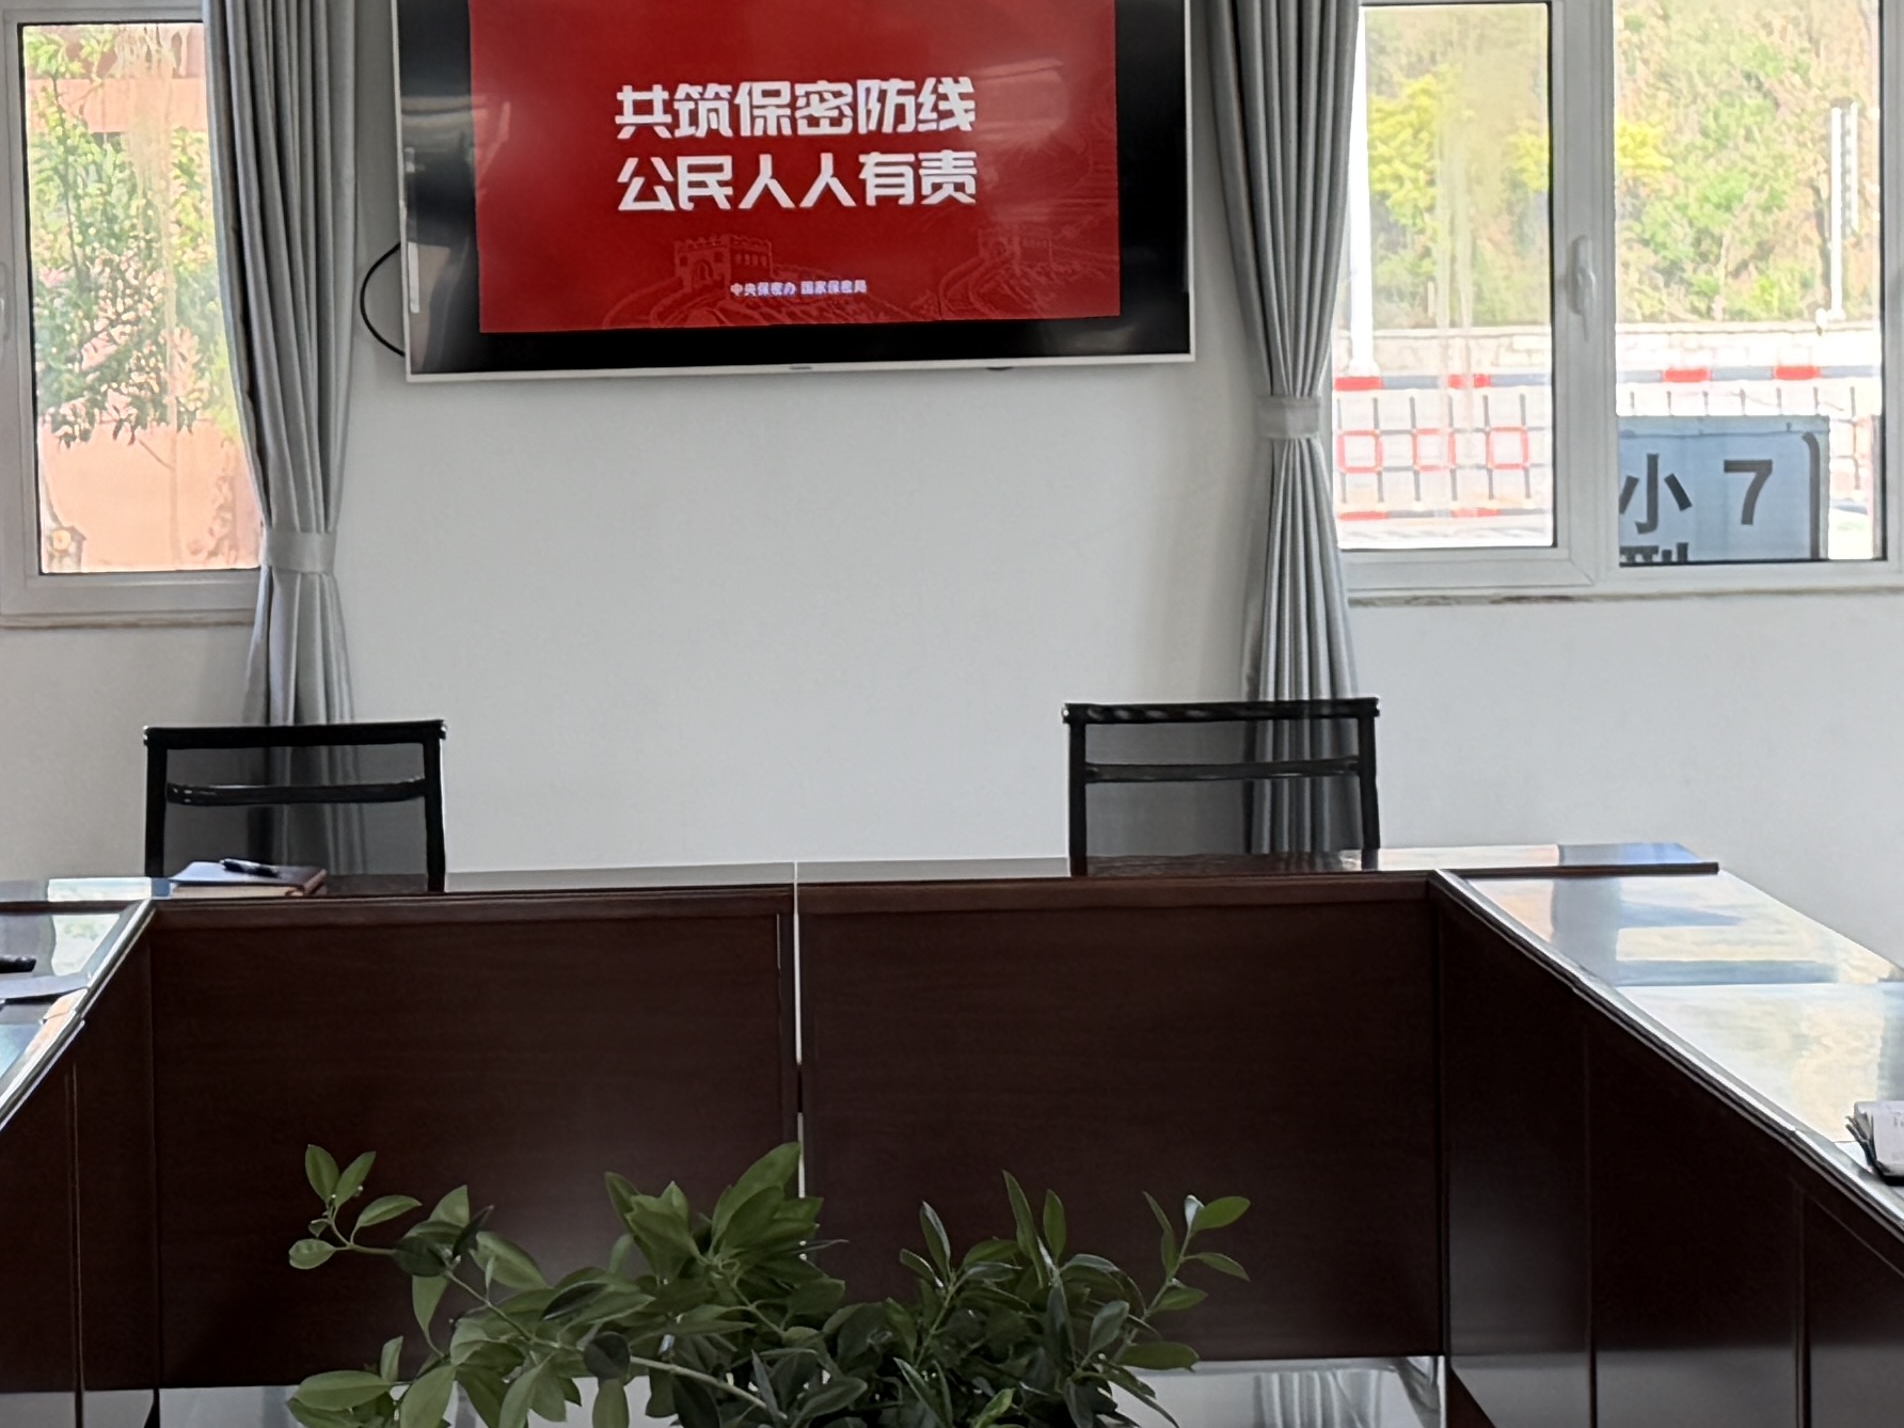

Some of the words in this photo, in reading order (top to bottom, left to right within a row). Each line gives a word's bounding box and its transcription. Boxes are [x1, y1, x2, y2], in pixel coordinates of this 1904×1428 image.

[614, 75, 976, 140] 共筑保密防线
[616, 149, 978, 212] 公民人人有责
